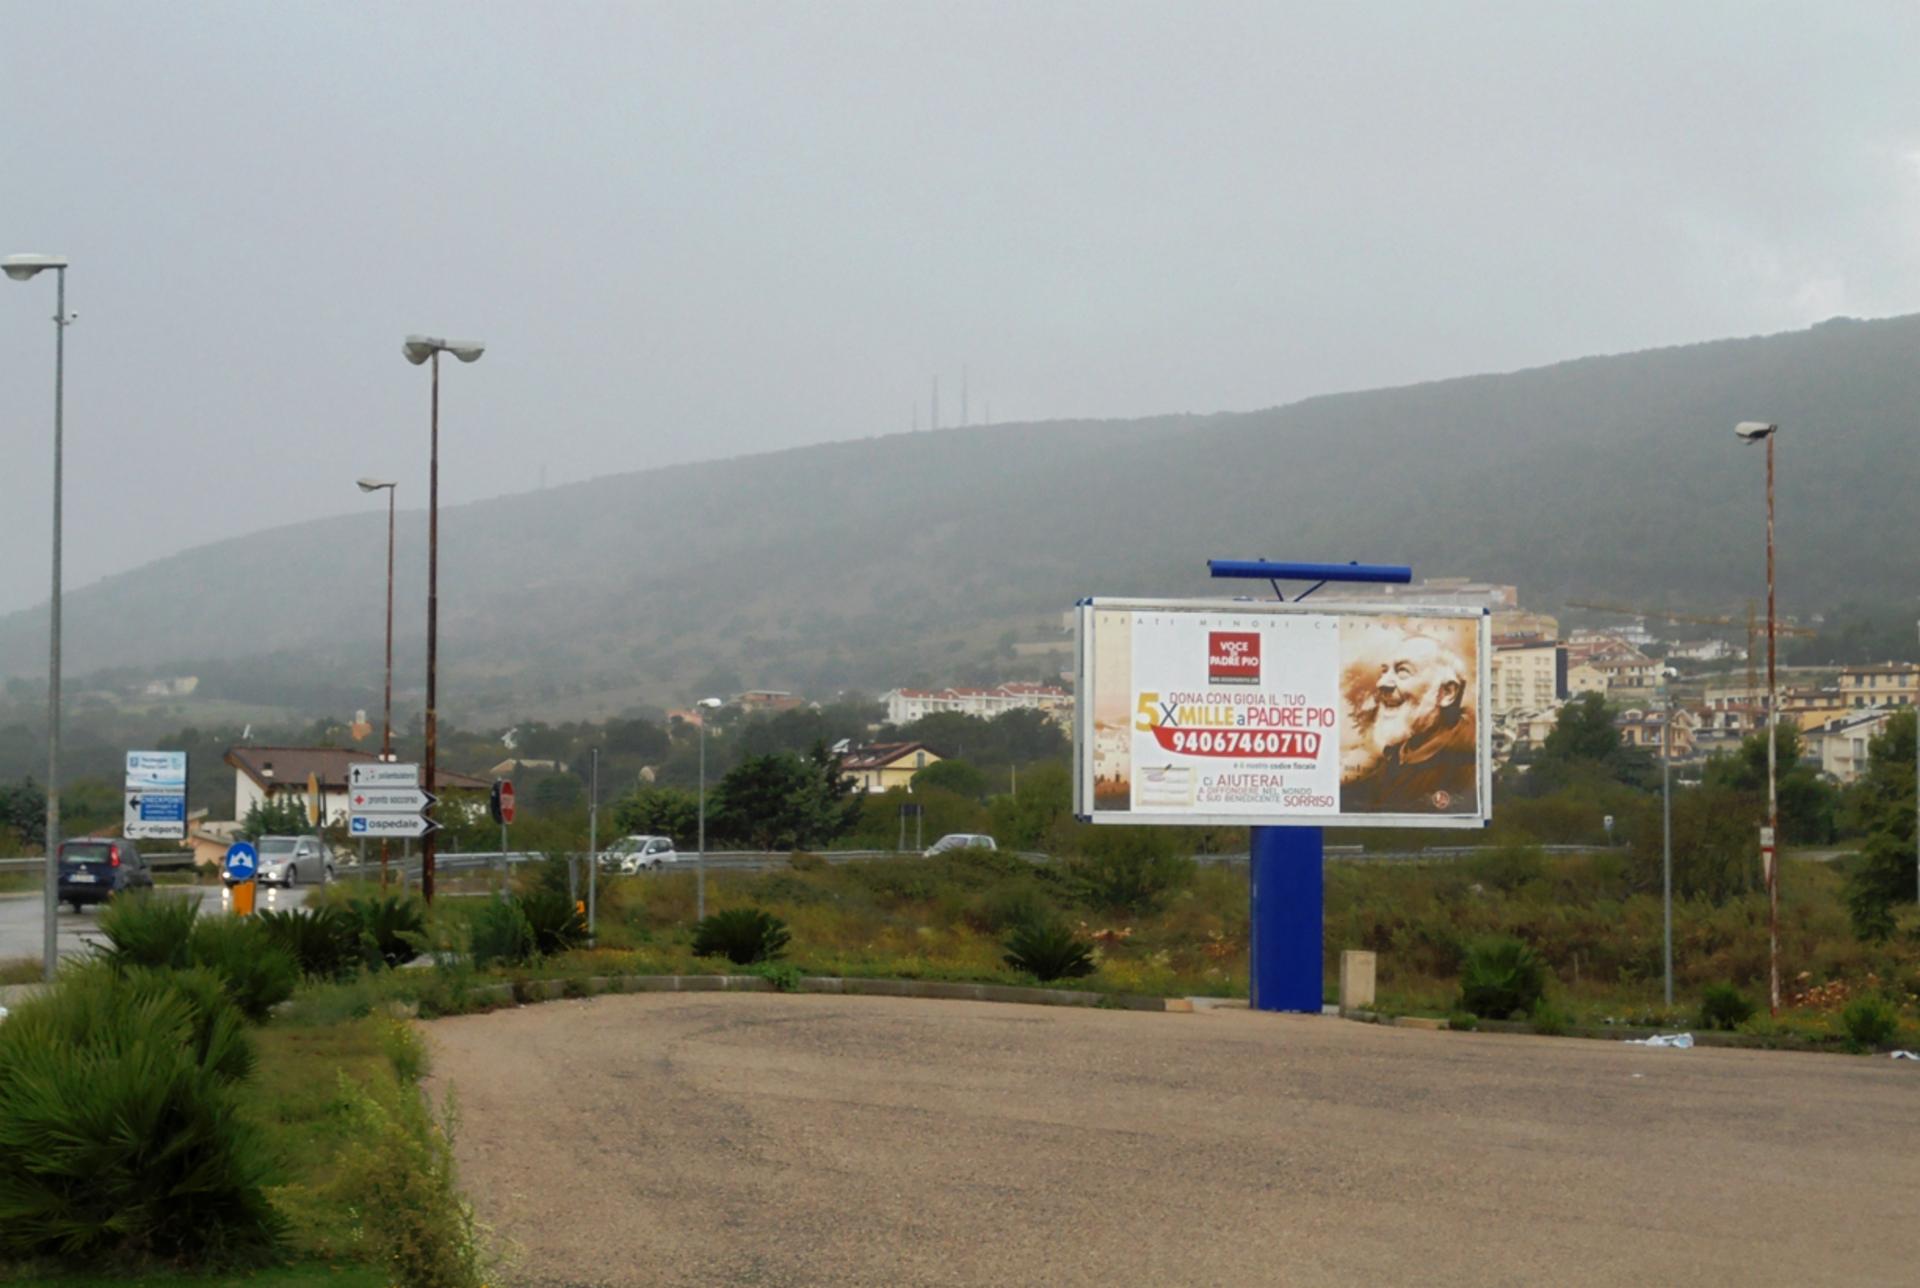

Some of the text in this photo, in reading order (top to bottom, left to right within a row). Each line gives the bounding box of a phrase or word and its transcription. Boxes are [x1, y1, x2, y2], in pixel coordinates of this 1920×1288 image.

[1220, 641, 1249, 651] VOCE
[1210, 656, 1259, 667] PADRE PIO
[1169, 692, 1306, 705] DONA CON GIOIA IL TUO
[1237, 714, 1246, 726] a
[1247, 707, 1303, 726] PADRE
[1307, 708, 1335, 727] PIO
[1172, 732, 1317, 754] 94067460710
[1217, 774, 1284, 787] AIUTERAI
[1284, 795, 1335, 808] SORRISO
[368, 819, 418, 830] ospedale
